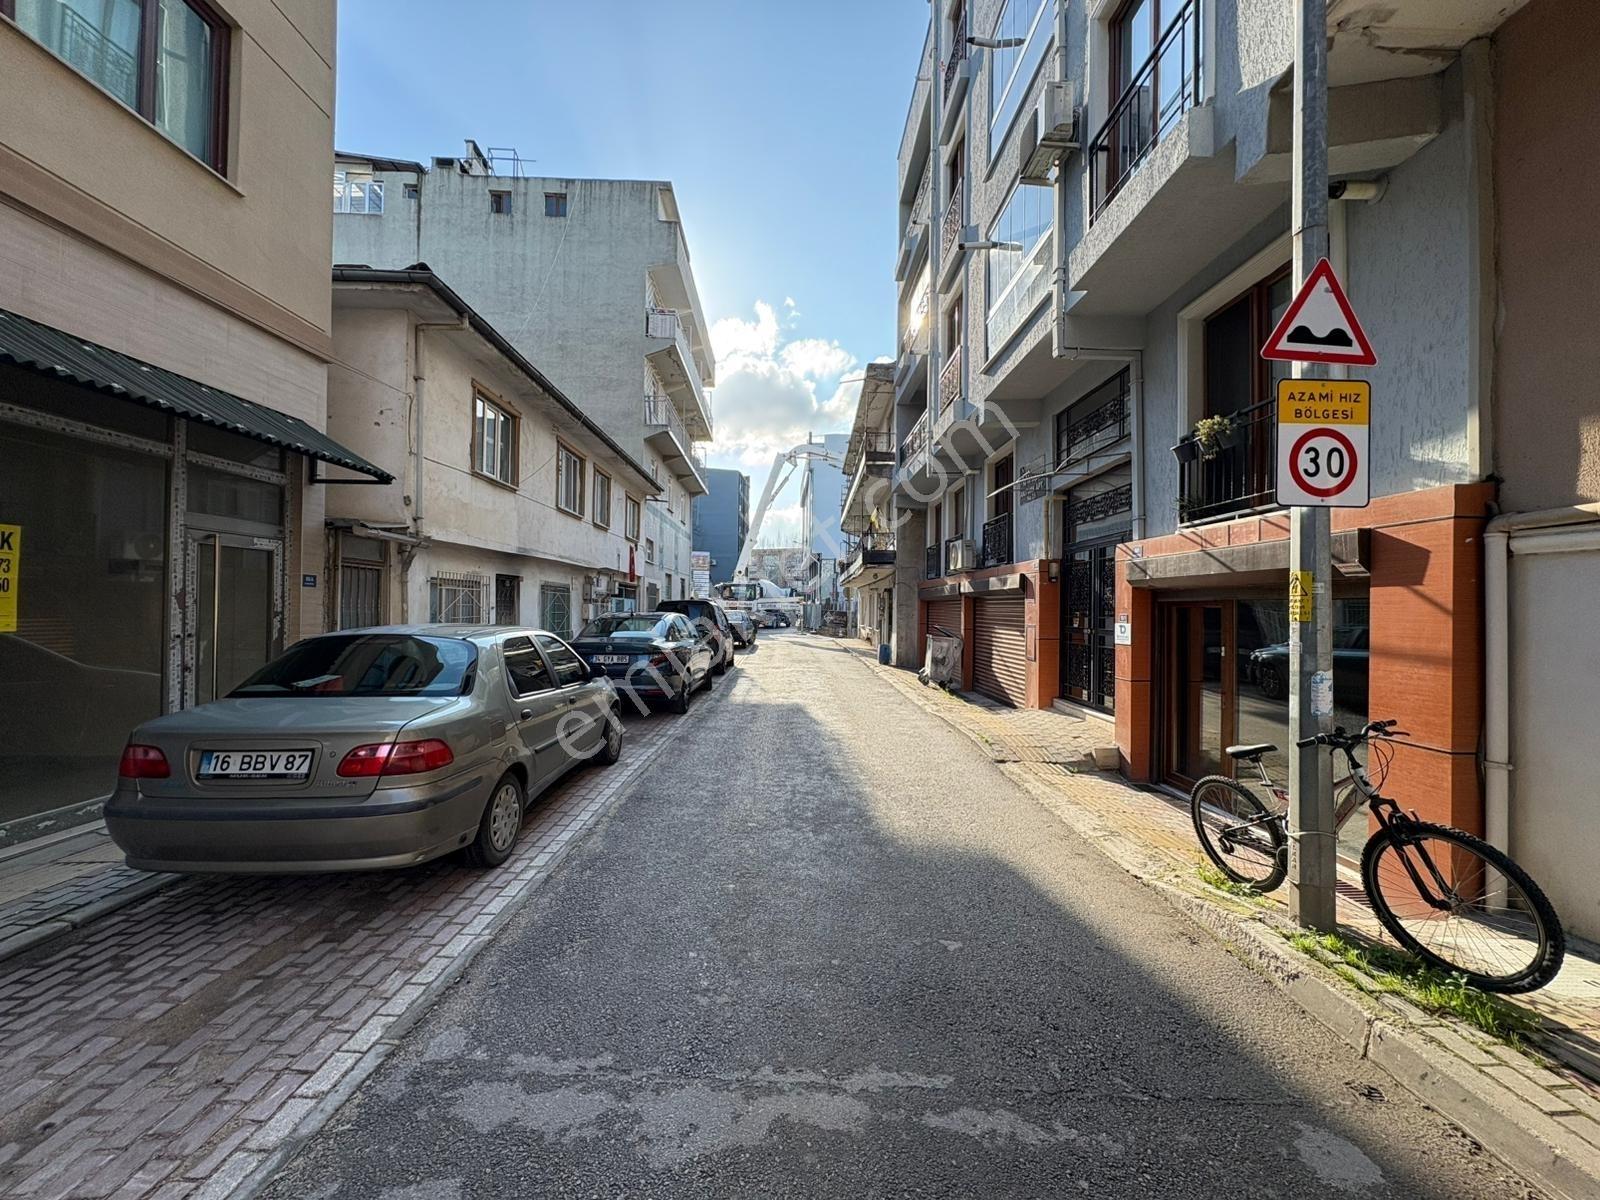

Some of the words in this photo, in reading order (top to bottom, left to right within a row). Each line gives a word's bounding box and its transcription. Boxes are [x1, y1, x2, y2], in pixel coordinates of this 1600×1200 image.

[1287, 390, 1333, 403] AZAMİ
[1339, 393, 1361, 403] HIZ
[1294, 406, 1354, 420] BÖLGESİ
[1303, 446, 1344, 478] 30
[0, 577, 10, 593] 0
[212, 754, 232, 772] 16
[238, 754, 282, 772] BBV
[284, 754, 310, 772] 87
